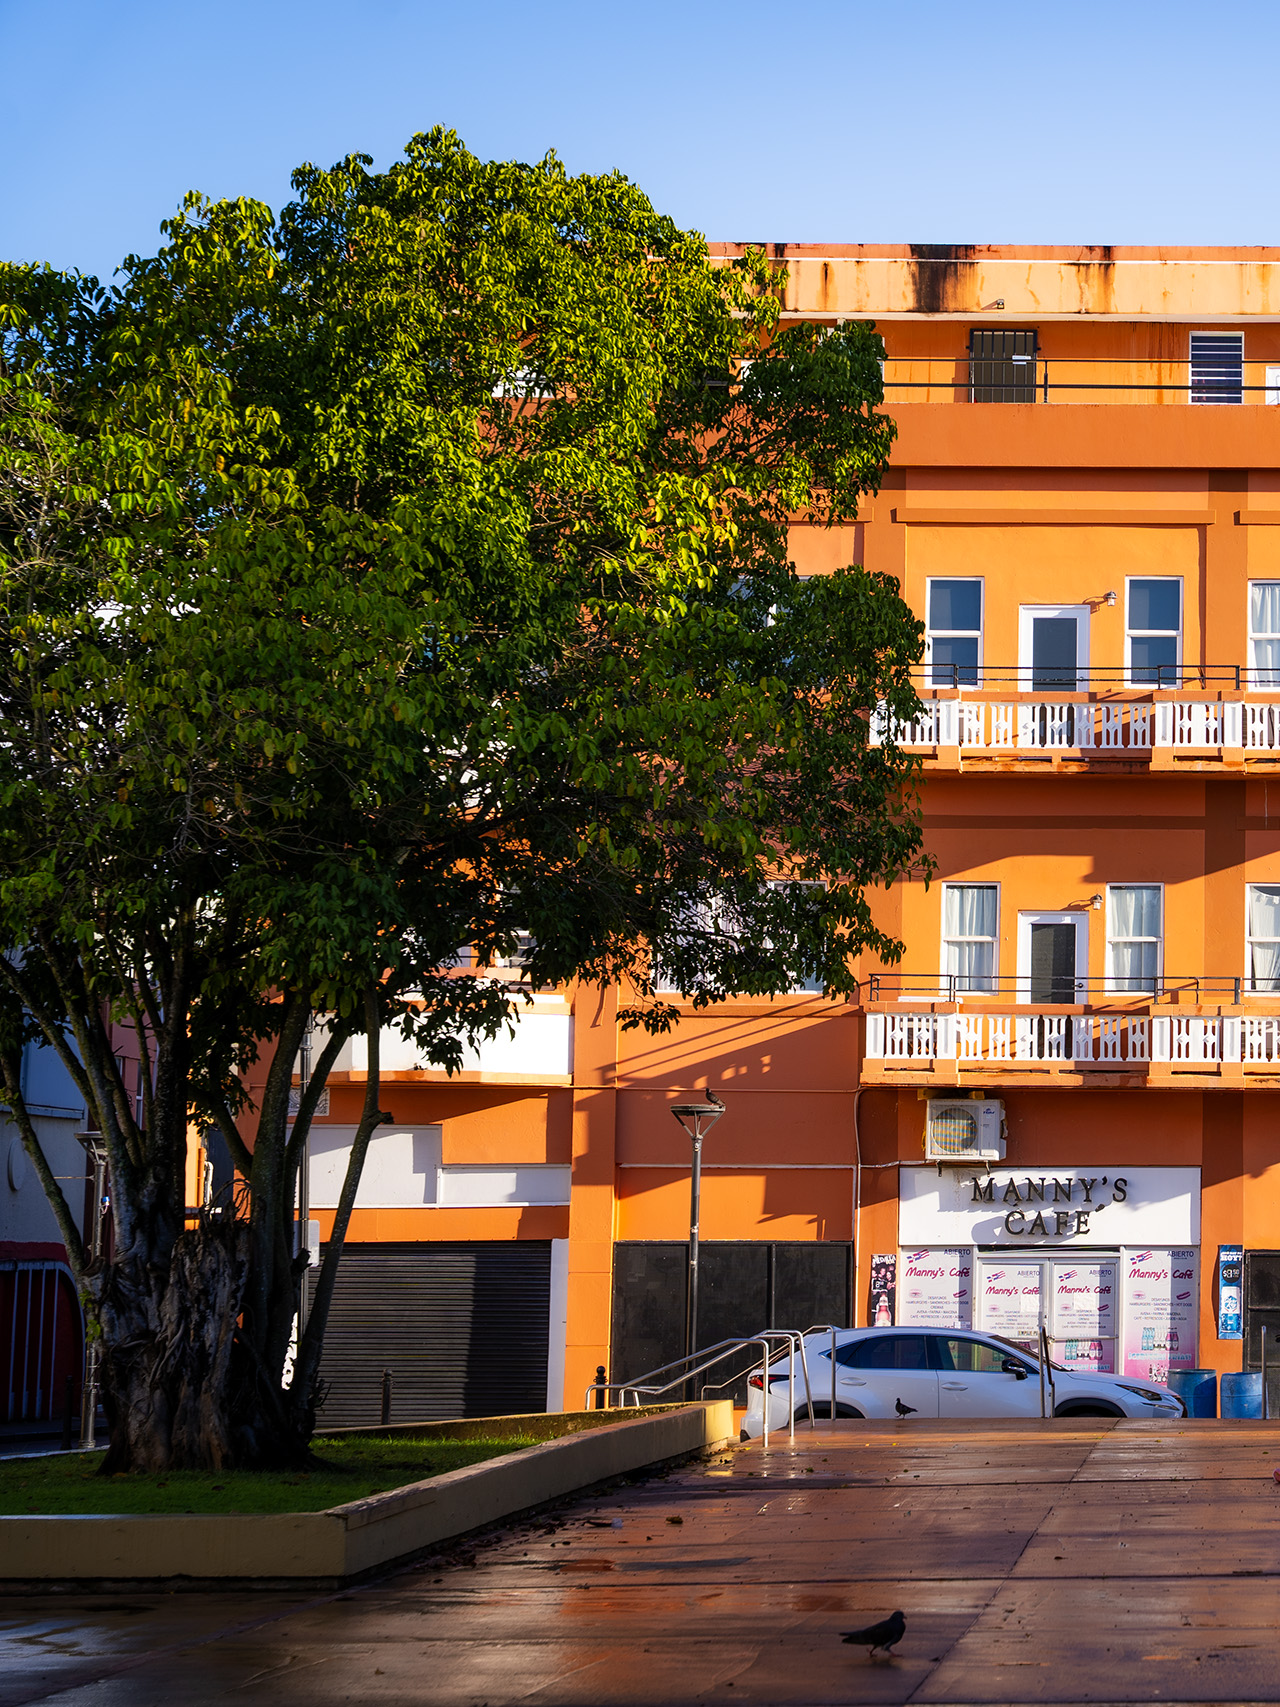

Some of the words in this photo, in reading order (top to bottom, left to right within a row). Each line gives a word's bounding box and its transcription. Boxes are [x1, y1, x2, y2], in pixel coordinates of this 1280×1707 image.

[971, 1176, 1128, 1202] MANNY'S
[906, 1266, 945, 1279] Manny's
[949, 1266, 970, 1277] Café
[1128, 1268, 1168, 1281] Manny's
[1172, 1269, 1194, 1279] Café
[986, 1286, 1018, 1296] Manny's
[1022, 1286, 1040, 1295] Café
[1094, 1285, 1112, 1294] Café
